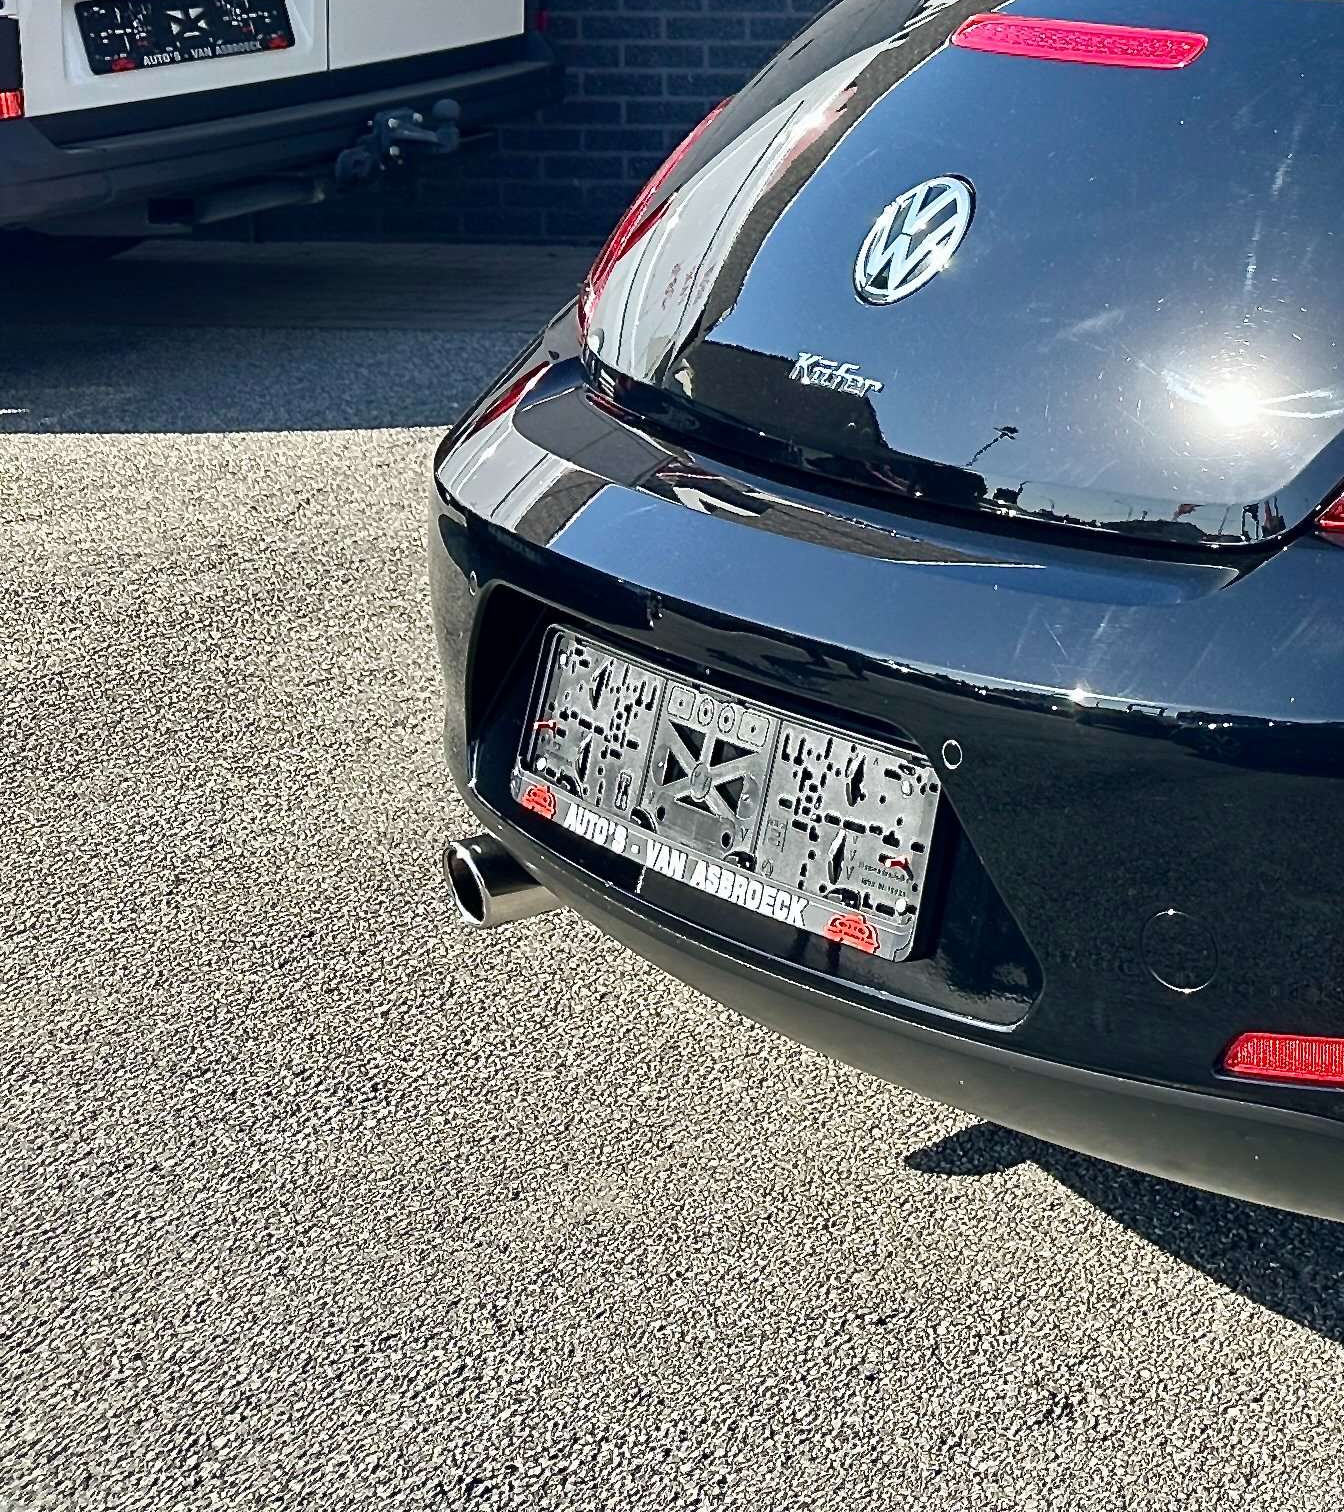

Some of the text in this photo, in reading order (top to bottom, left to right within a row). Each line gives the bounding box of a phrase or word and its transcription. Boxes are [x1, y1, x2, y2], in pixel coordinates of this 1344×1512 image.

[191, 44, 212, 59] VAN
[563, 803, 629, 855] AUTO'S
[646, 838, 689, 880] VAN
[690, 859, 810, 927] ASBROECK
